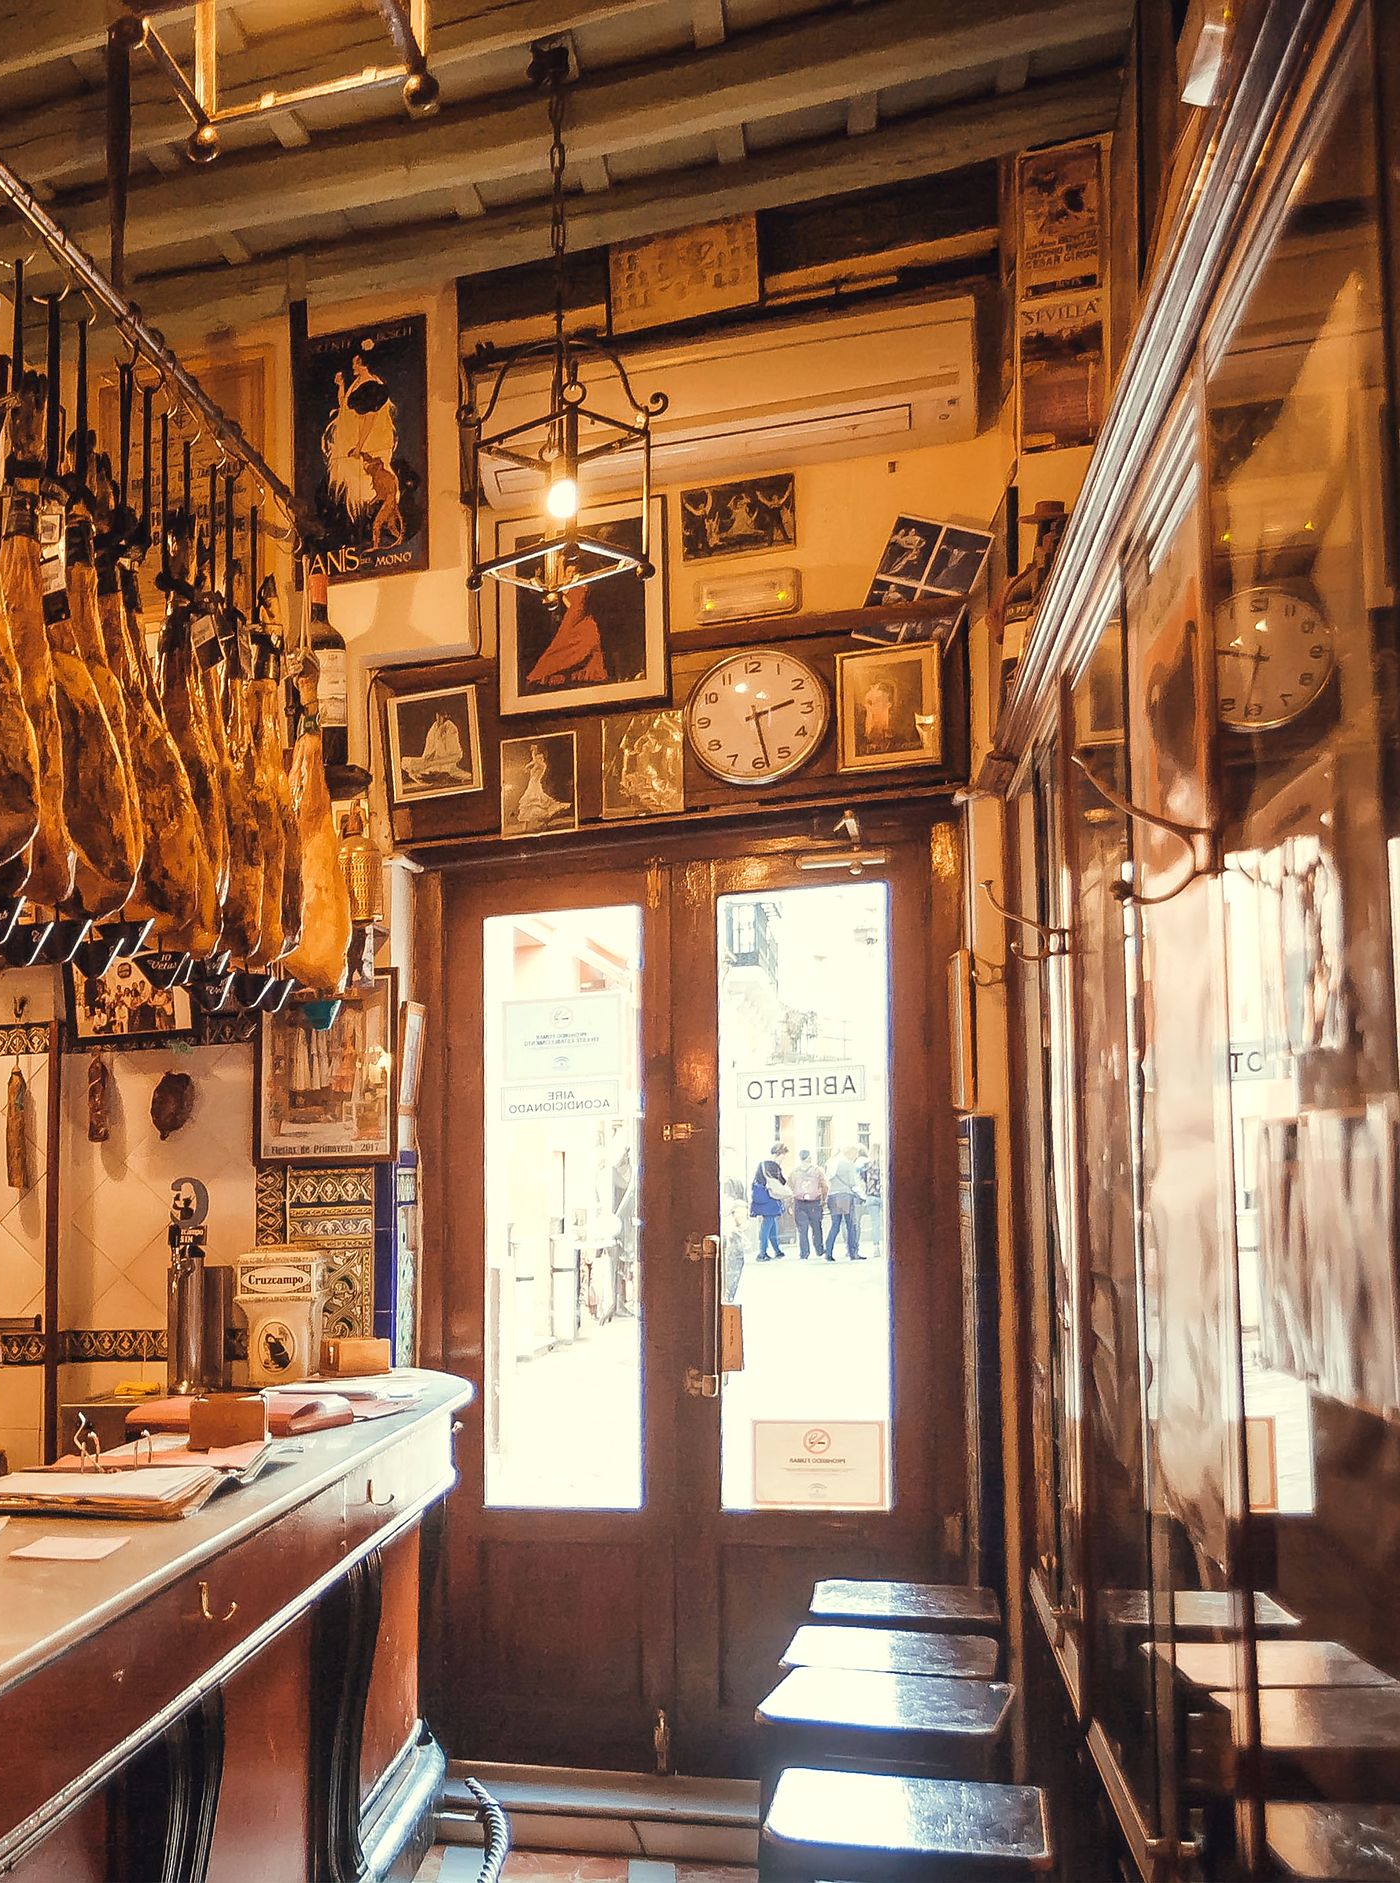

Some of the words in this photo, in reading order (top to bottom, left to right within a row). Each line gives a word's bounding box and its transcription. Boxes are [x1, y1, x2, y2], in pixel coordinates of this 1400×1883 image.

[374, 551, 412, 567] MONO
[744, 661, 762, 674] 12
[722, 673, 732, 686] 11
[791, 678, 805, 691] 2
[705, 692, 719, 705] 10
[800, 700, 814, 714] 3
[697, 717, 711, 729] 9
[794, 725, 808, 738] 4
[707, 739, 722, 751] 8
[777, 746, 791, 759] 5
[726, 754, 739, 766] 7
[751, 757, 765, 769] 6
[360, 1142, 380, 1152] 2017
[248, 1275, 304, 1287] Cruzcampo
